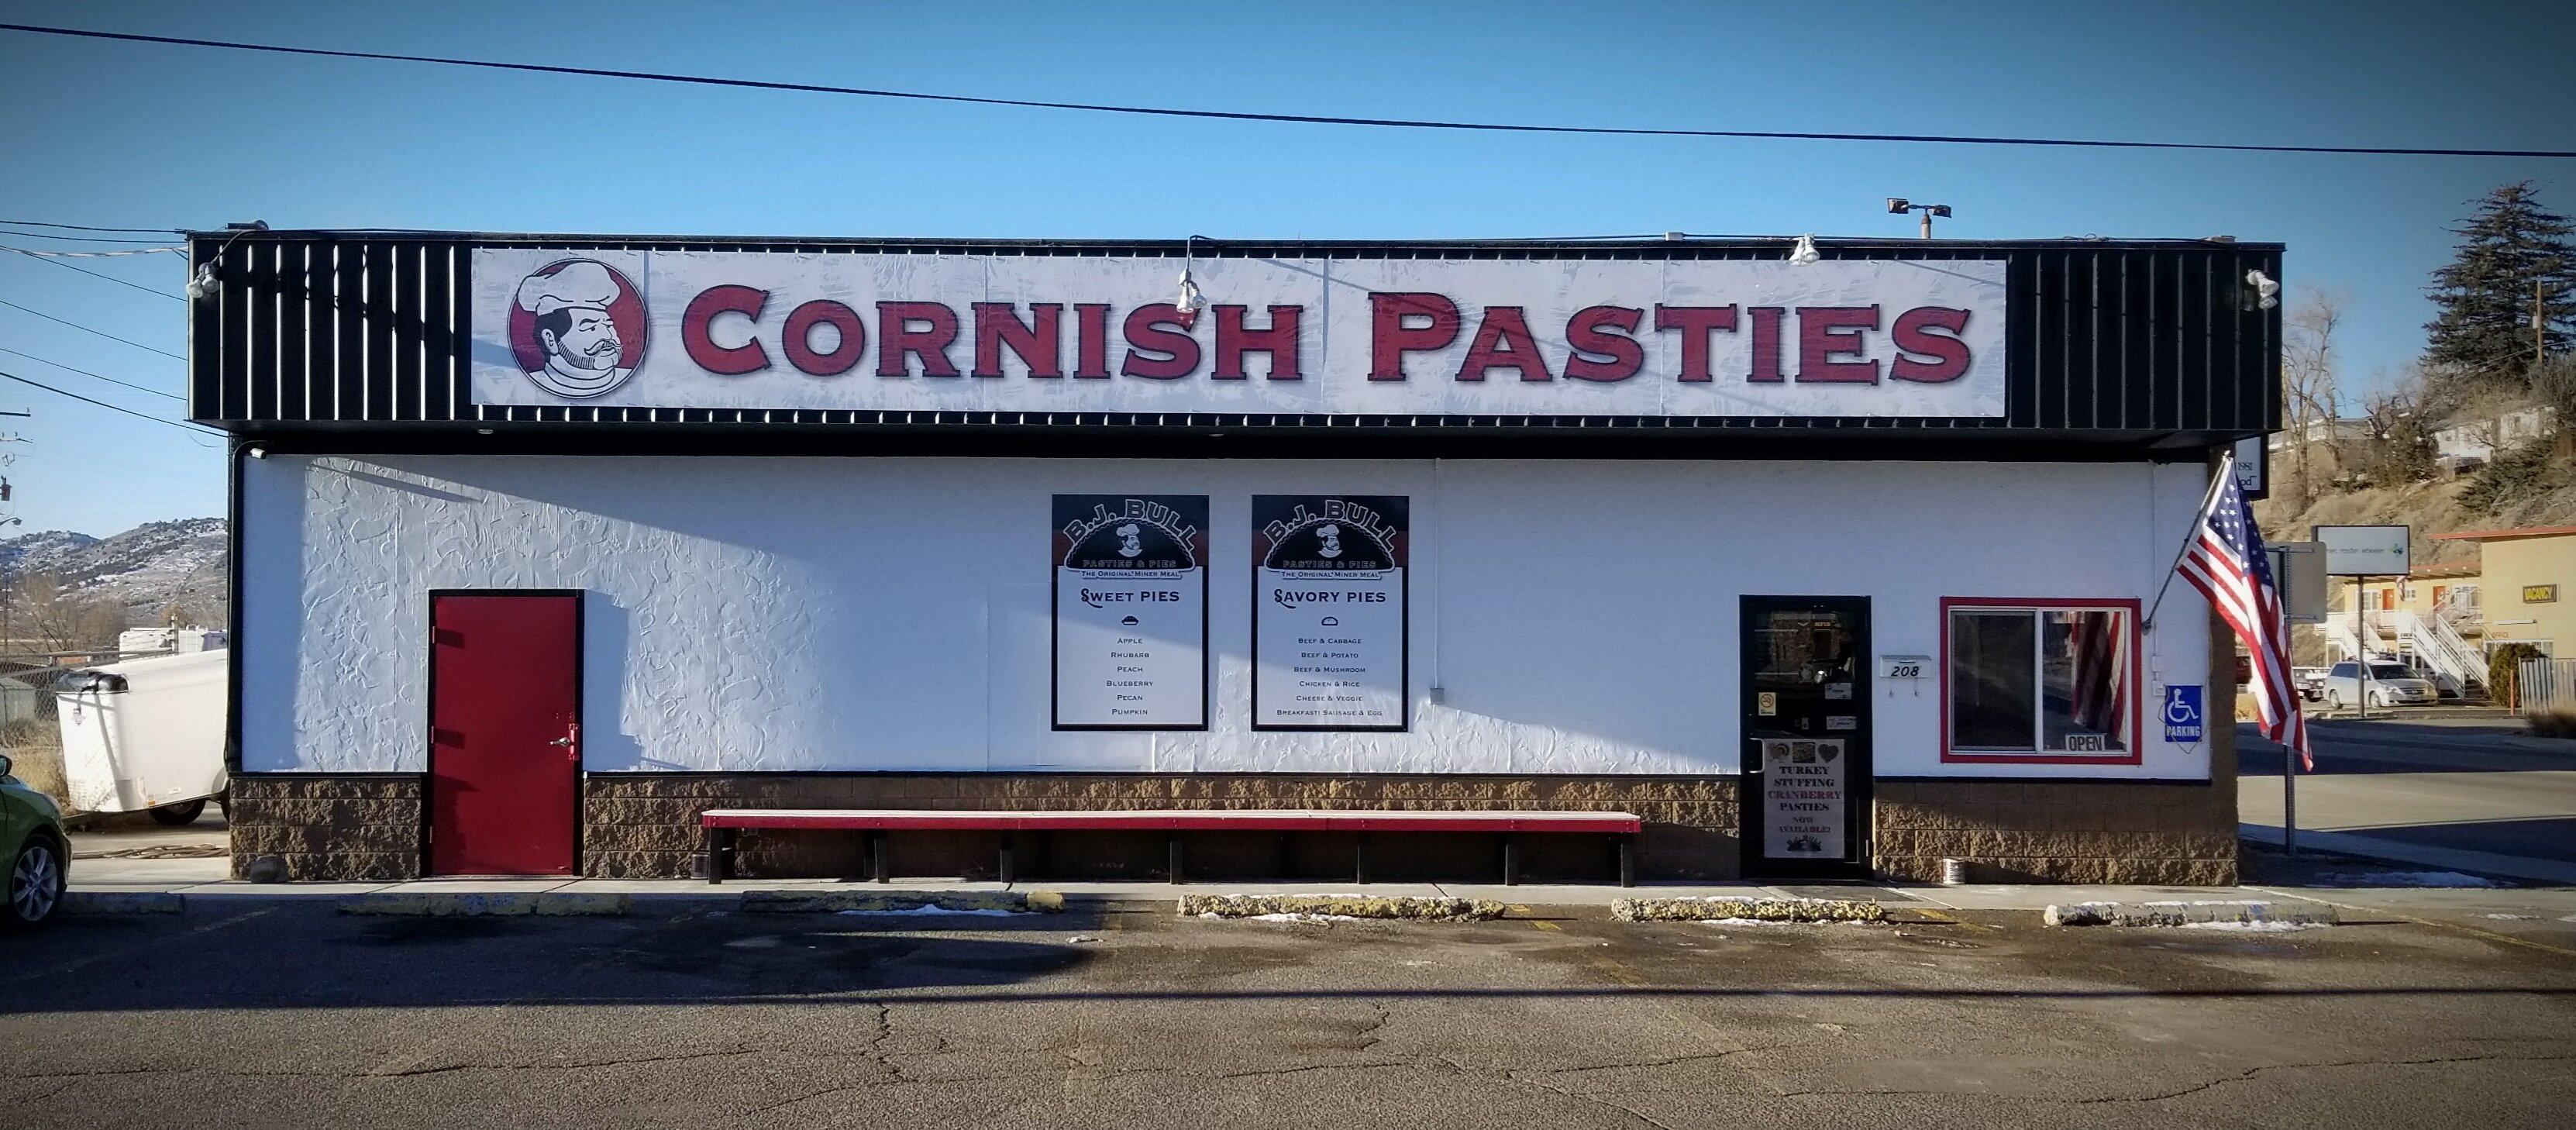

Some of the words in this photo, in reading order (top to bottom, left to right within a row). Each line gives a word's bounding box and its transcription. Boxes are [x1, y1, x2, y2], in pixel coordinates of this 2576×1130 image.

[681, 284, 1303, 381] CORNISH
[1367, 291, 1972, 387] PASTIES
[1063, 504, 1117, 545] B.J.
[1125, 498, 1197, 552] BULL
[1262, 504, 1317, 546] B.J.
[1324, 499, 1396, 553] BULL
[1083, 560, 1133, 568] PASTIES
[1137, 560, 1145, 568] &
[1149, 560, 1177, 568] PIES
[1283, 560, 1333, 569] PASTIES
[1336, 560, 1345, 569] &
[1348, 560, 1377, 569] PIES
[1080, 588, 1134, 608] SWEET
[1141, 591, 1180, 602] PIES
[1274, 588, 1340, 609] SAVORY
[1347, 591, 1386, 603] PIES
[2525, 587, 2552, 600] VACANCY
[1891, 666, 1920, 677] 208
[2167, 725, 2201, 737] PARKING
[2068, 736, 2102, 751] OPEN
[1779, 766, 1829, 775] TURKEY
[1774, 778, 1835, 787] STUFFING
[1768, 790, 1842, 800] CRANBERRY
[1780, 802, 1829, 811] PASTIES
